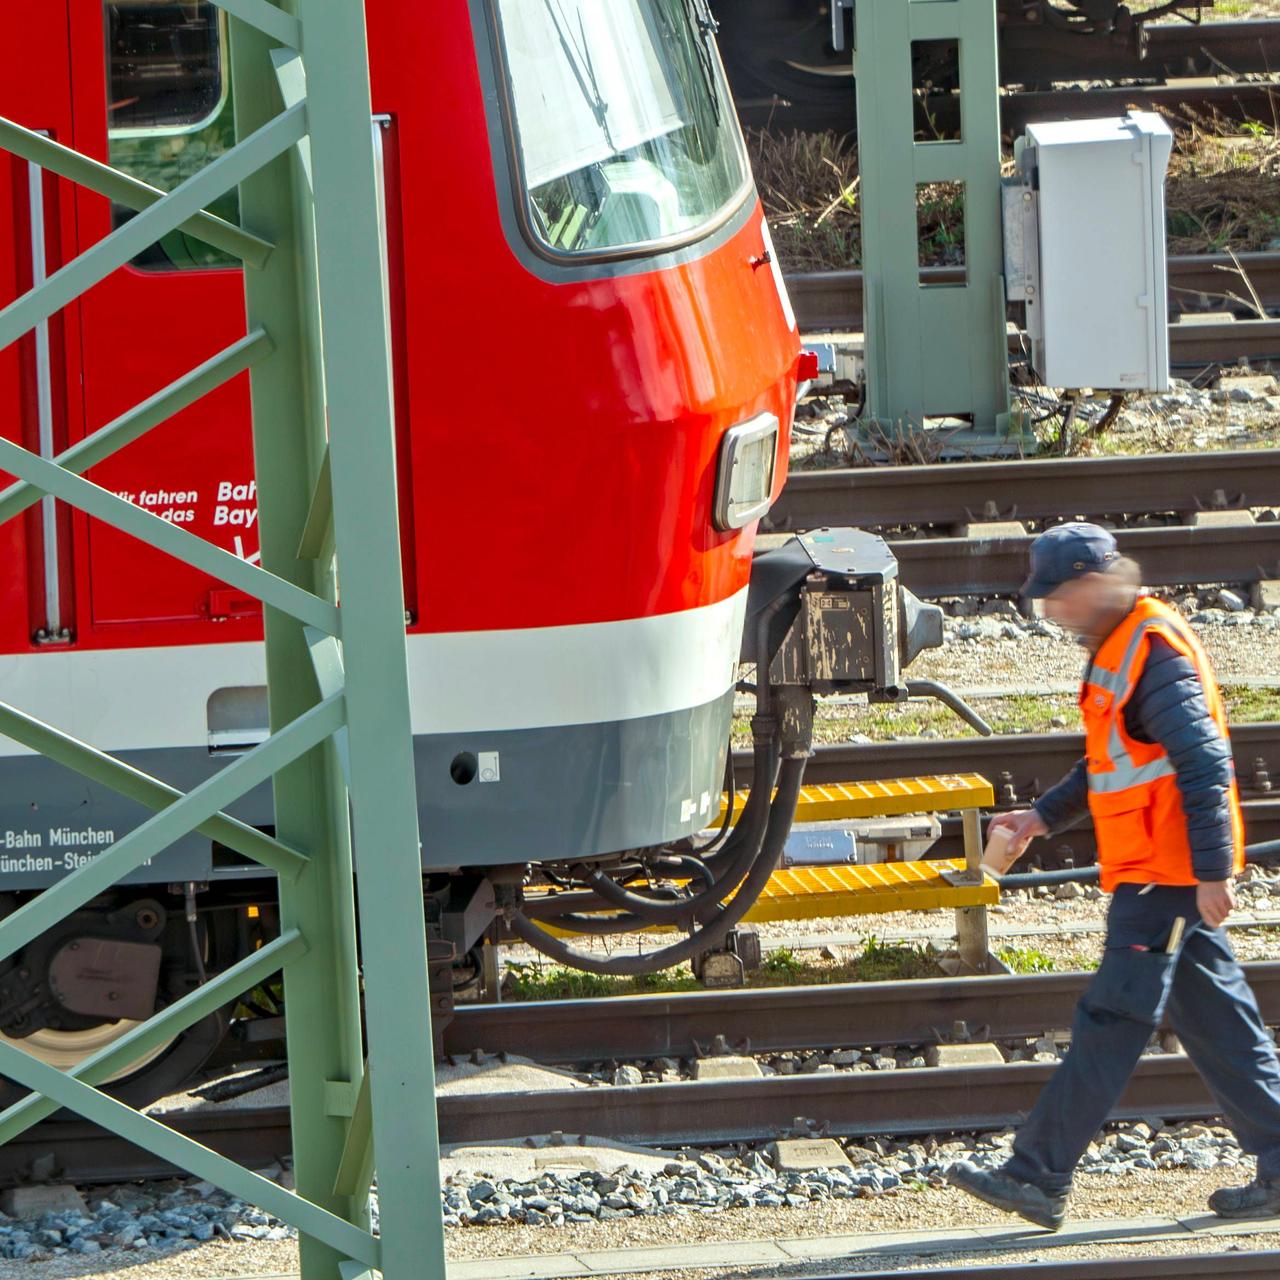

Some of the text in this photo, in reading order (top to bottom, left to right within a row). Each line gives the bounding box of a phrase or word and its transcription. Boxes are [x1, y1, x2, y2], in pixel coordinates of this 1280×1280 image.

[139, 490, 198, 506] fahren
[161, 508, 195, 522] das
[213, 505, 258, 529] Bay
[49, 827, 115, 846] München
